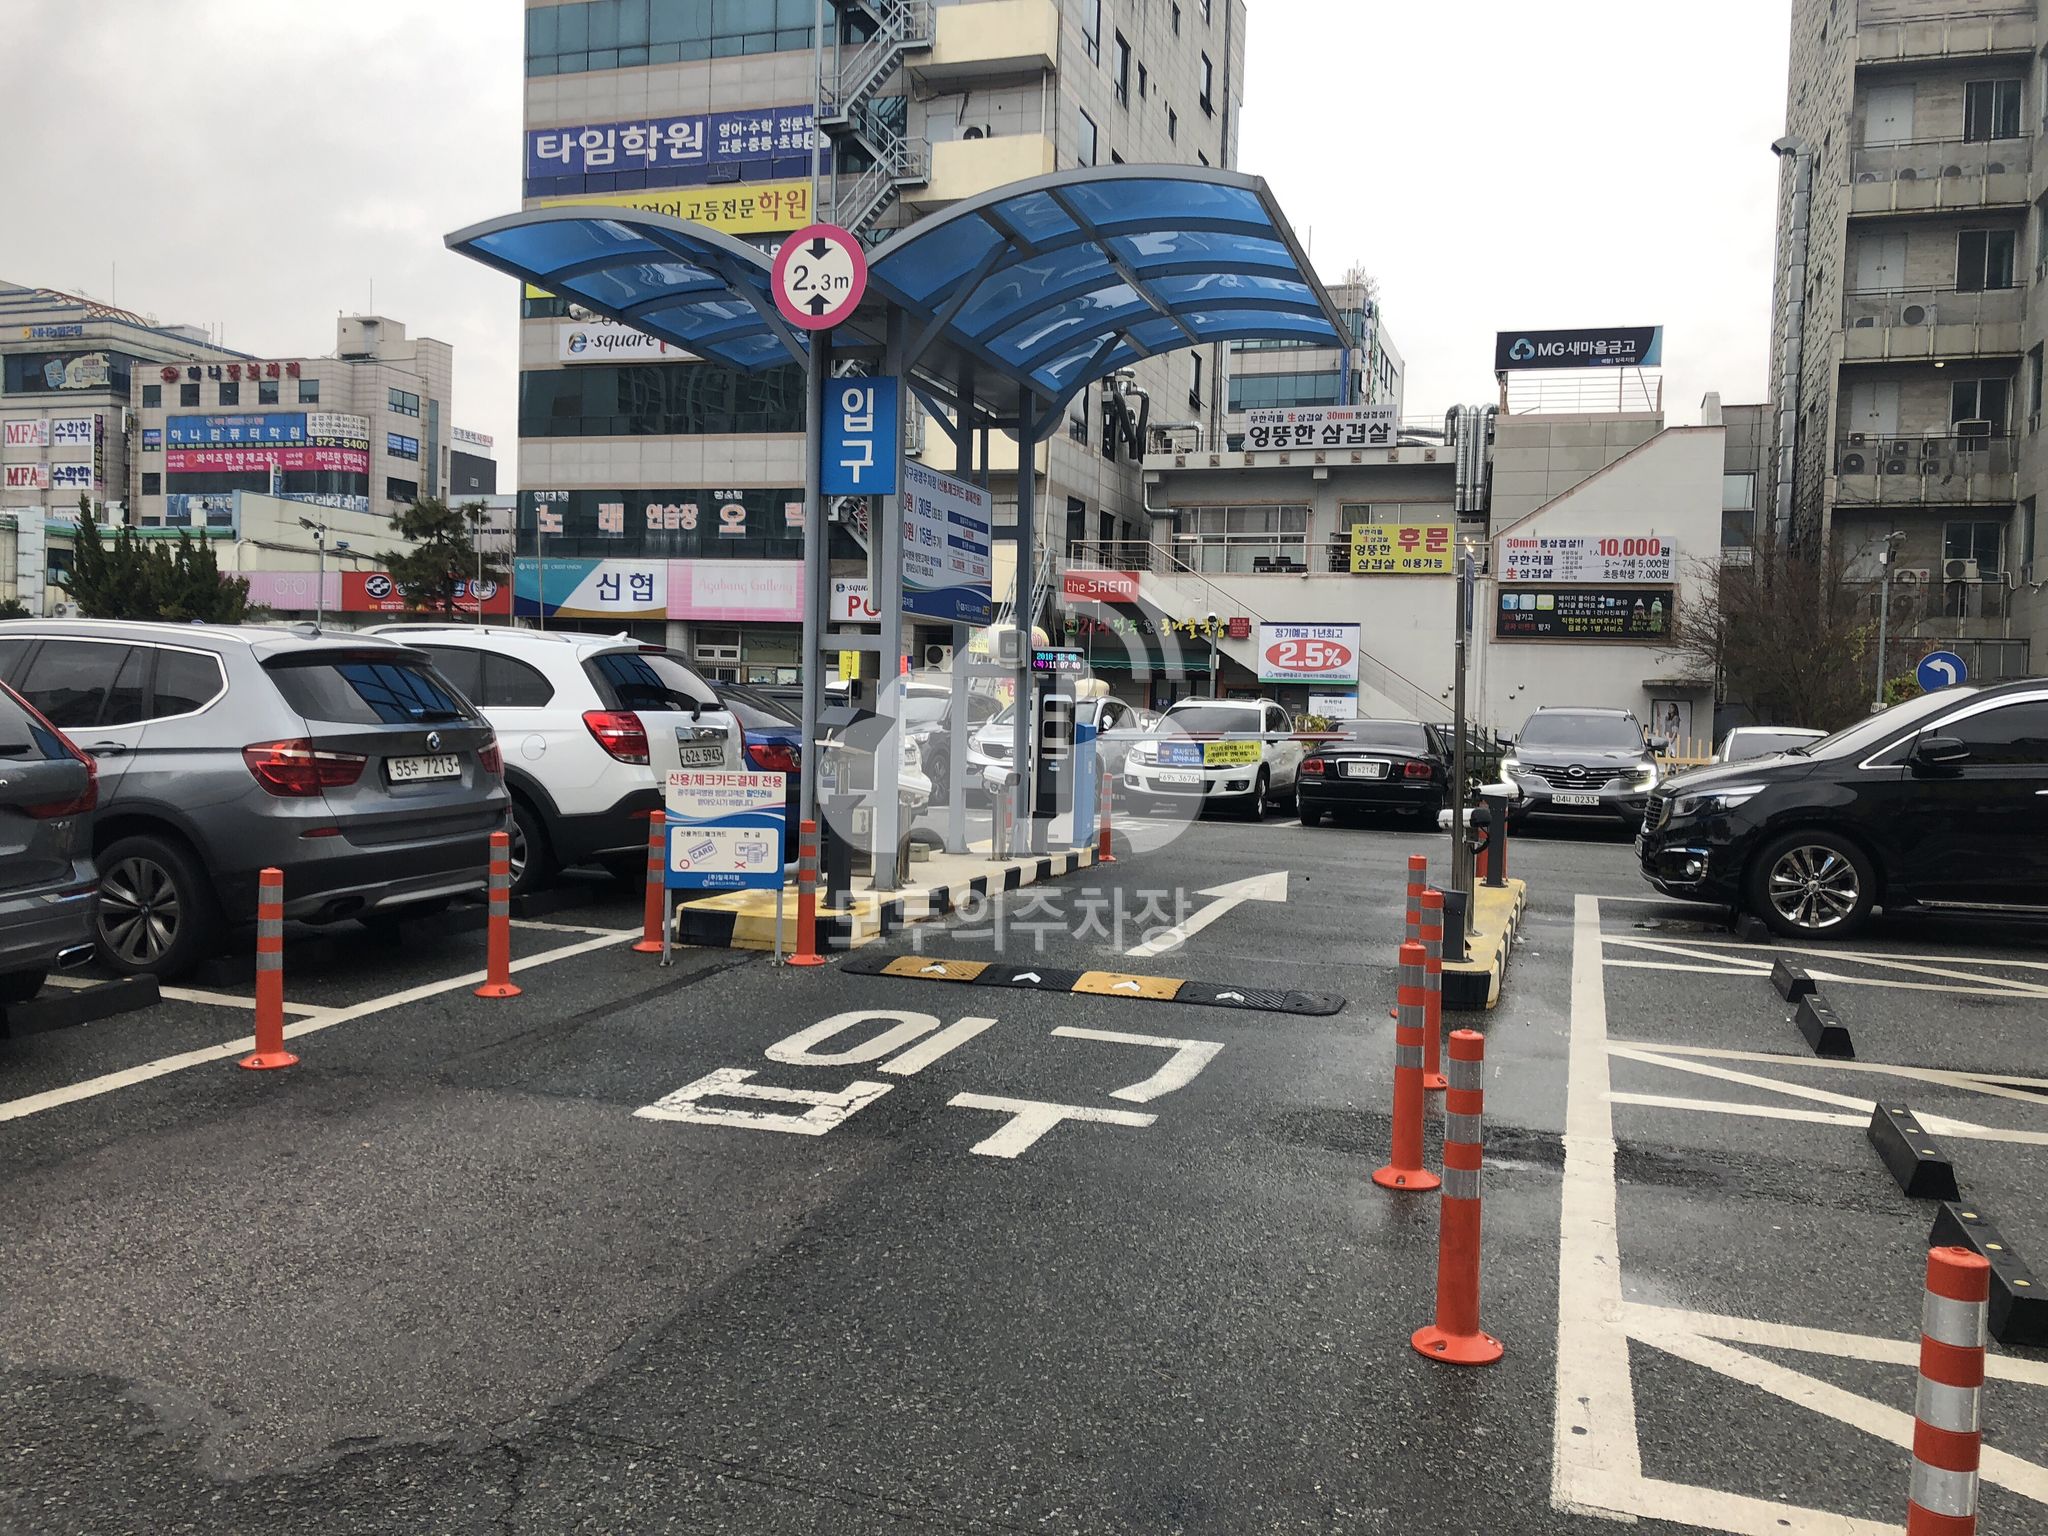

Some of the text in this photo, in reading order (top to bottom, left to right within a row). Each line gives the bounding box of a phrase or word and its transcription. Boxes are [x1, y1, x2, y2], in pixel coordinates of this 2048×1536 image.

[718, 119, 773, 138] 영어·수학
[536, 121, 704, 167] 타임학원
[685, 198, 756, 222] 고등전문
[758, 188, 807, 222] 학원
[792, 265, 849, 291] 2.3m
[1287, 412, 1296, 423] 生
[1297, 413, 1323, 422] 삼겹살
[1326, 411, 1354, 421] 30mm
[7, 424, 37, 444] MFA
[171, 426, 301, 441] 하나컴퓨터학원
[840, 387, 874, 484] 입구
[1249, 422, 1392, 448] 엉뚱한 삼겹살
[316, 437, 368, 450] 572-5400
[7, 467, 37, 486] MFA
[646, 504, 699, 531] 연습장
[1397, 528, 1449, 553] 후문
[1506, 539, 1538, 548] 30mm
[1354, 544, 1392, 556] 엉뚱한
[1358, 558, 1443, 570] 삼겹살 이용가능
[1508, 555, 1554, 566] 무한리필
[1506, 568, 1554, 580] 生 삼겹살
[1602, 569, 1635, 580] 초등학생
[596, 572, 654, 602] 신협
[1067, 581, 1085, 593] the
[1275, 628, 1309, 639] 정기예금
[1278, 641, 1342, 668] 2.5%
[395, 757, 454, 777] 55수 7213
[669, 773, 783, 788] 신용/체크카드결제 전용
[1574, 795, 1596, 804] 0233
[692, 845, 714, 860] CARD
[632, 1009, 1226, 1160] 입구
